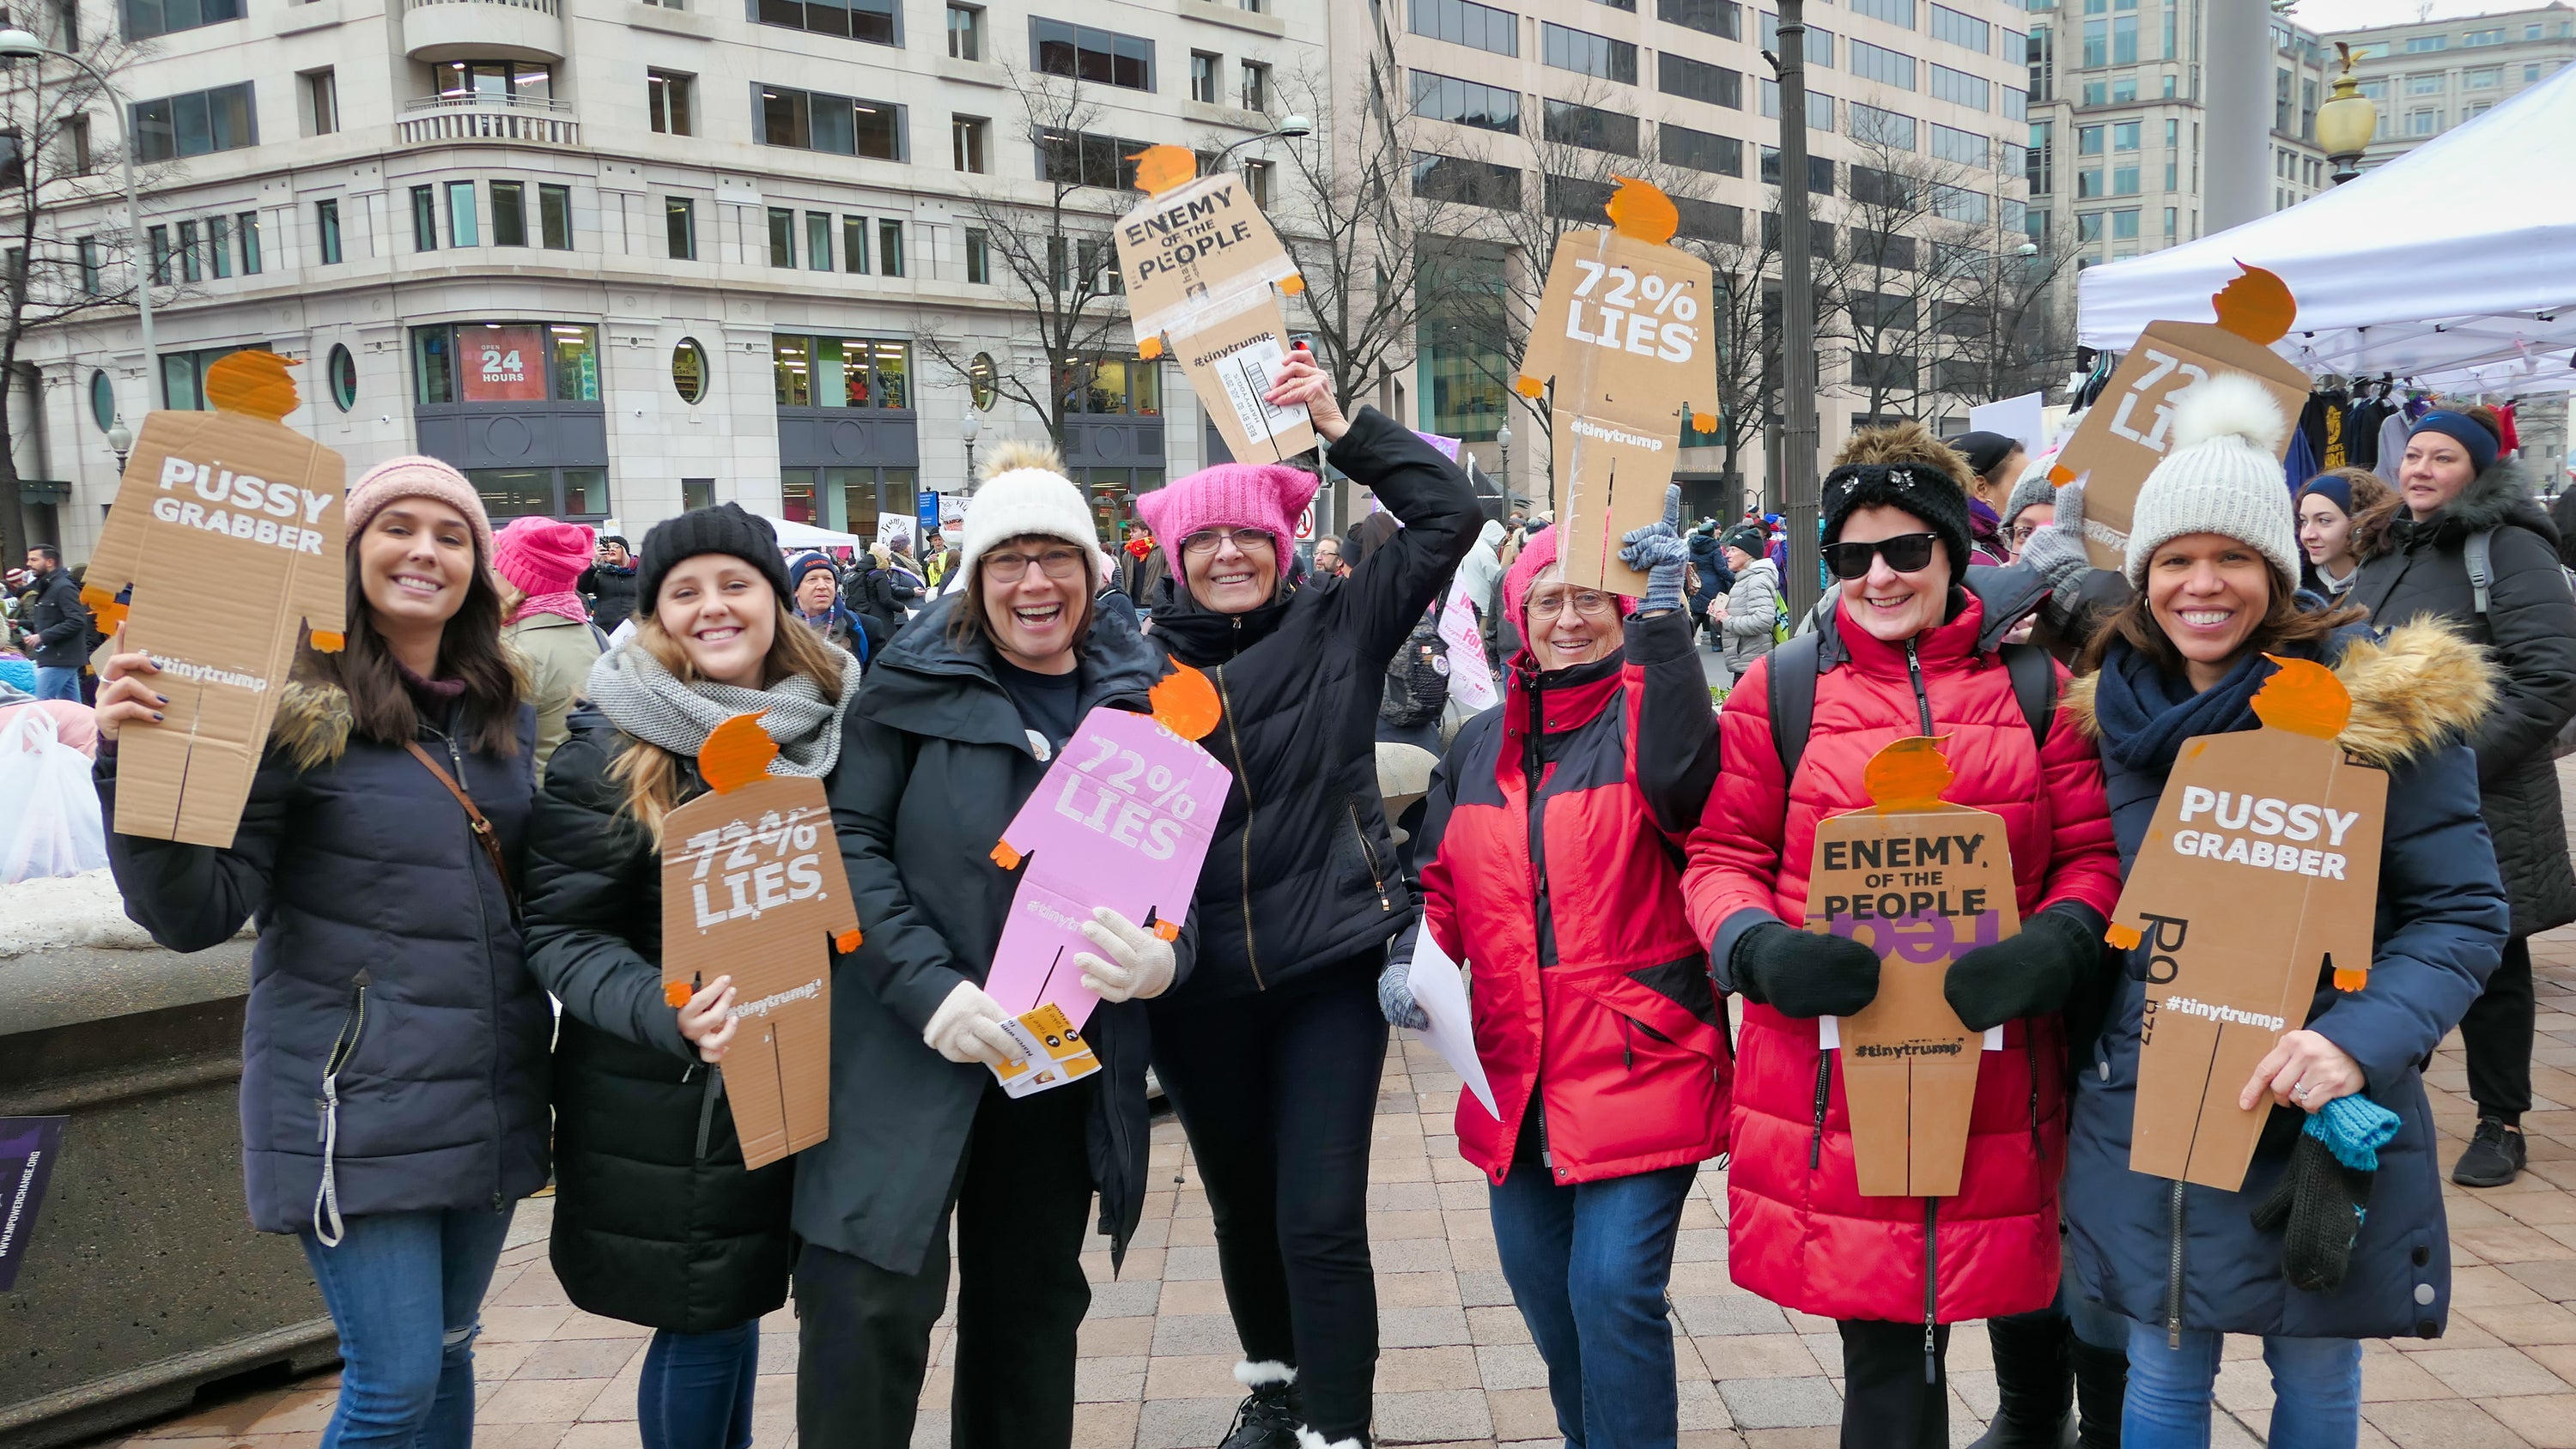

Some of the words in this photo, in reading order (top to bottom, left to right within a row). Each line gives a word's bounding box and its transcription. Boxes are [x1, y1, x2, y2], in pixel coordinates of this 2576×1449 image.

[1125, 185, 1232, 246] ENEMY
[1162, 232, 1182, 247] OF
[1184, 219, 1215, 238] THE
[1139, 221, 1251, 281] PEOPLE
[1573, 259, 1698, 321] 72%
[1194, 331, 1271, 367] #tinytrump
[1565, 300, 1693, 363] LIES
[482, 349, 523, 373] 24
[483, 373, 524, 382] HOURS
[2132, 349, 2210, 404] 72
[1242, 413, 1250, 422] BY
[1245, 423, 1258, 438] BEST
[1571, 421, 1662, 452] #tinytrump
[2109, 391, 2175, 452] LI
[160, 456, 334, 524] PUSSY
[153, 497, 324, 555] GRABBER
[1078, 734, 1196, 820] 72%
[1054, 773, 1183, 860] LIES
[2178, 785, 2360, 846] PUSSY
[686, 809, 817, 879] 72%
[1824, 834, 1985, 870] ENEMY
[2173, 829, 2347, 881] GRABBER
[692, 853, 823, 928] LIES
[1825, 888, 1986, 922] PEOPLE
[1865, 874, 1894, 888] OF
[1900, 871, 1943, 887] THE
[1027, 900, 1084, 935] #tinytr
[2166, 996, 2285, 1032] #tinytrump
[1855, 1042, 1963, 1058] #tinytrump
[0, 1150, 40, 1258] WWW.MPOWERCHANGE.ORG
